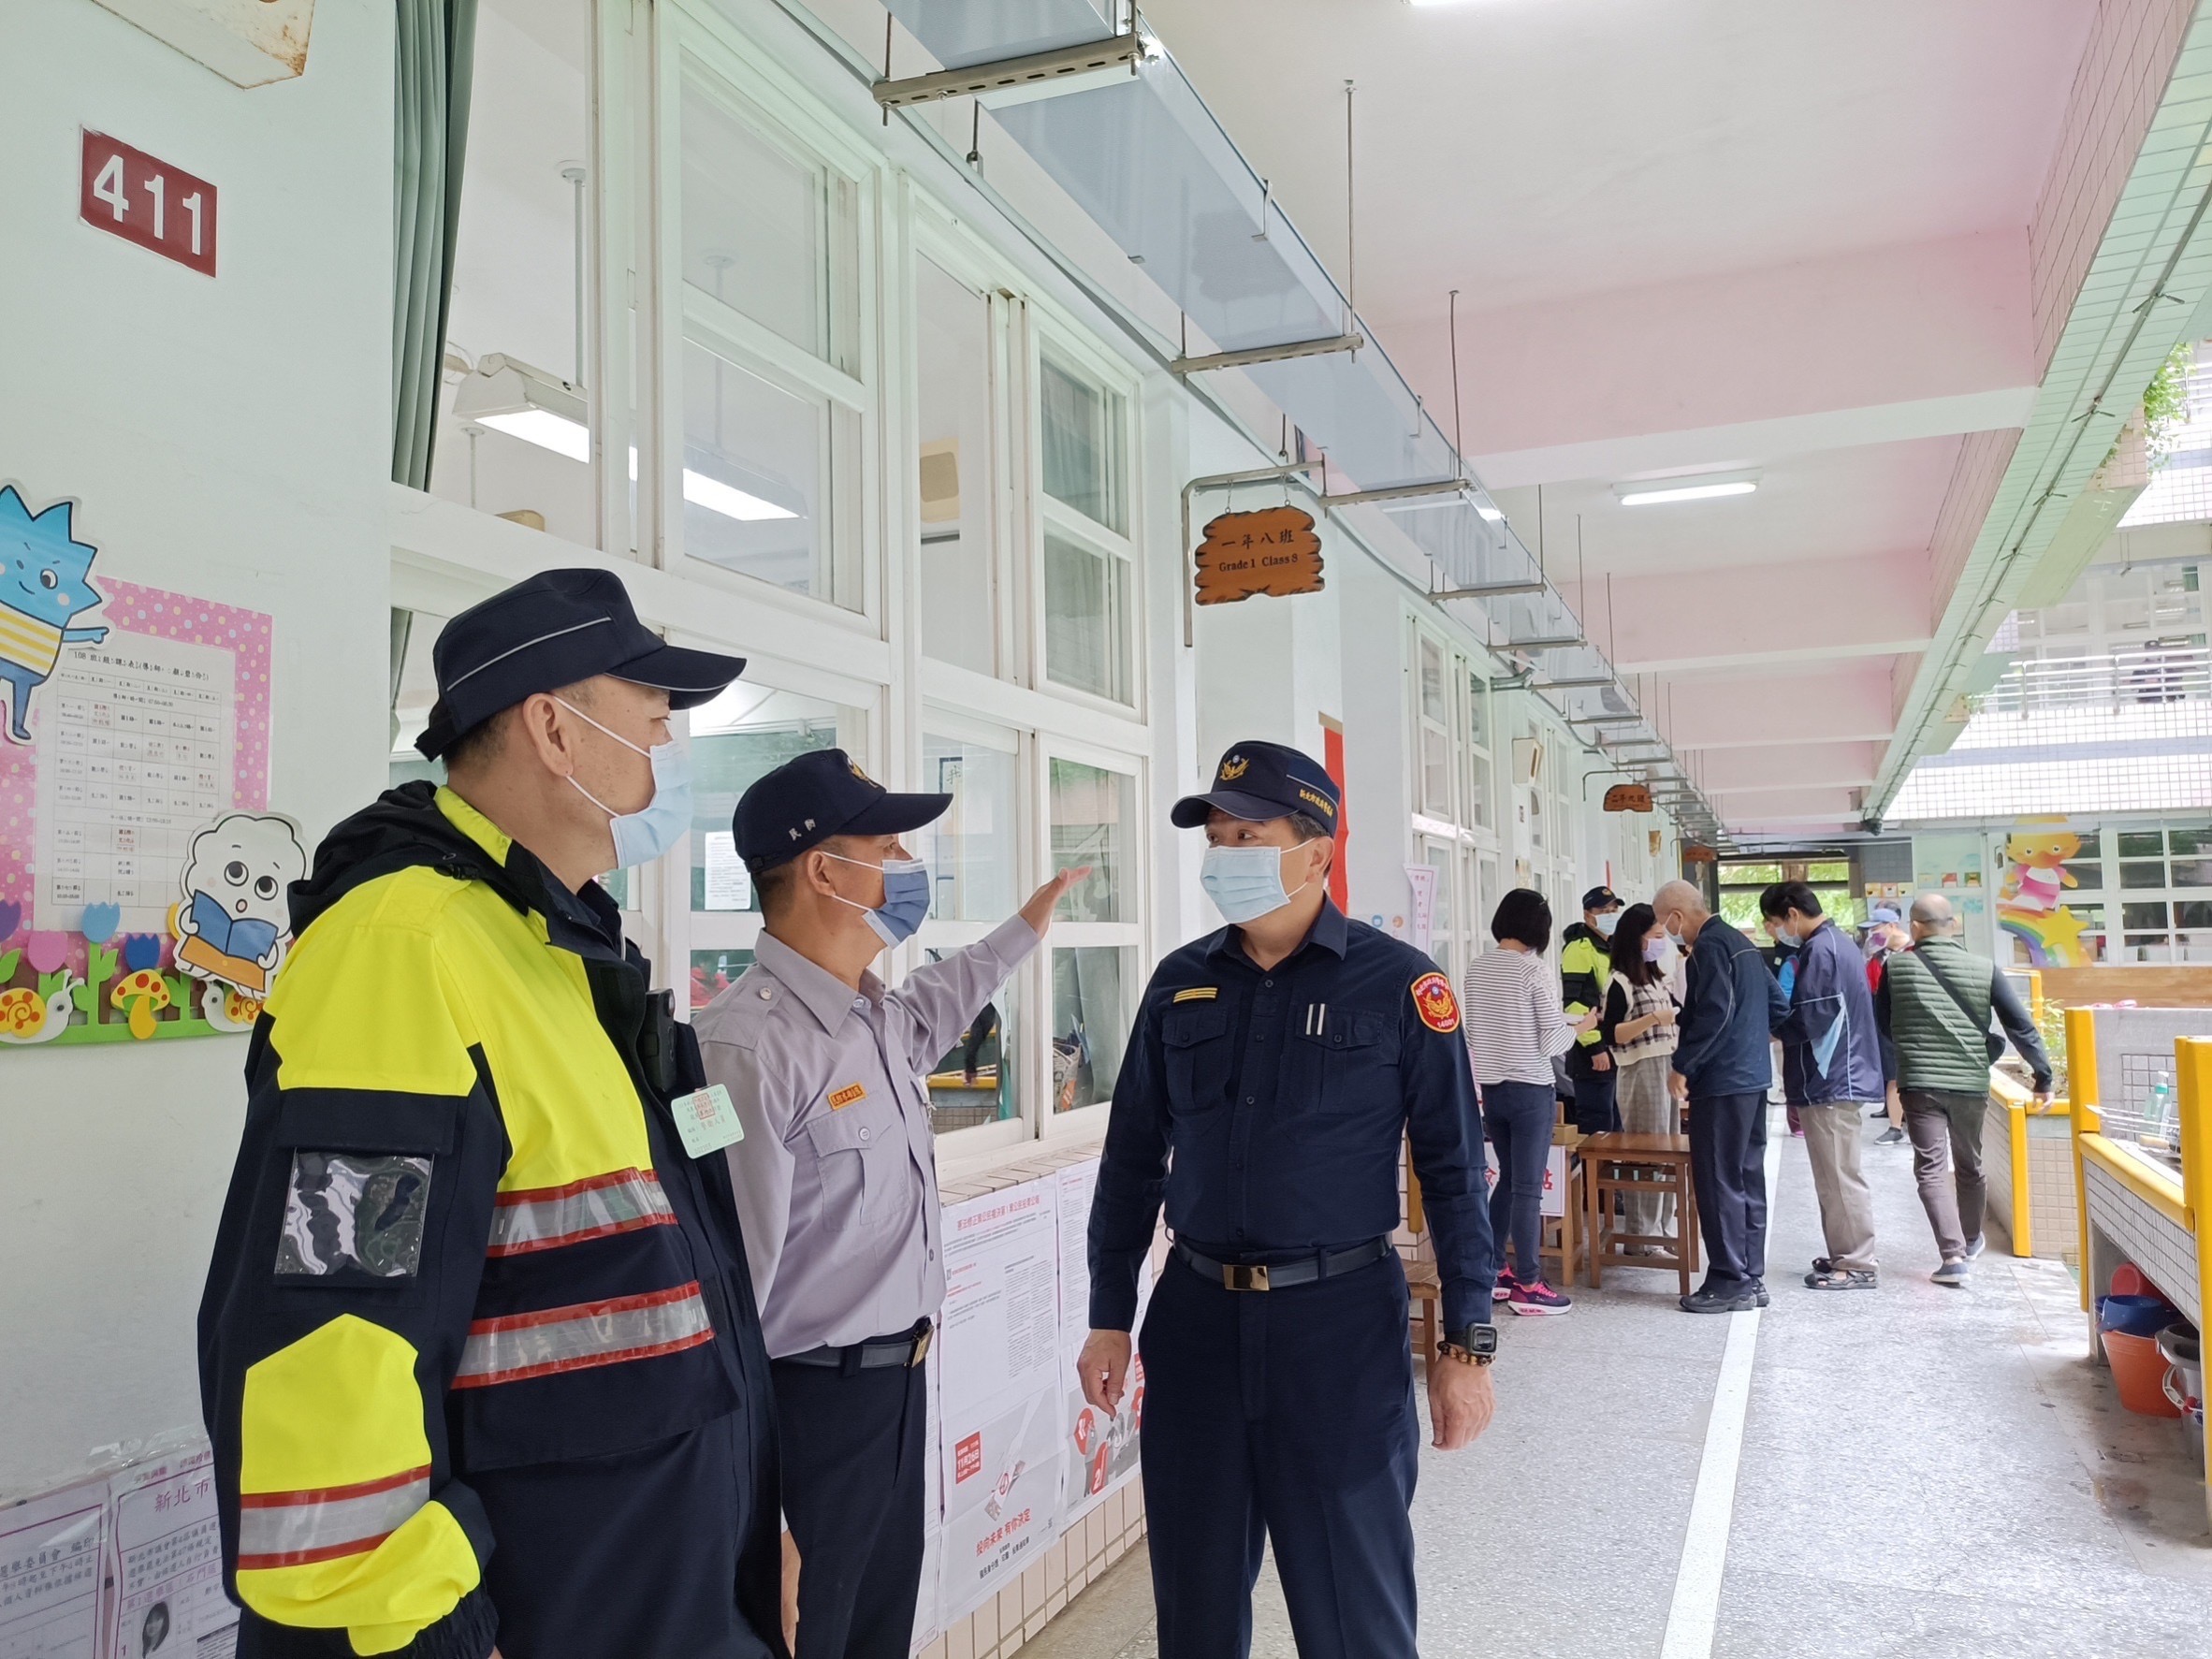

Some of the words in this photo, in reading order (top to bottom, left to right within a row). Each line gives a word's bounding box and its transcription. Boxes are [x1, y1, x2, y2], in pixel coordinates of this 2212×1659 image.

[93, 154, 201, 256] 411
[1221, 529, 1295, 550] 一年八班
[1219, 560, 1248, 572] Grade
[1251, 559, 1256, 569] 1
[1261, 556, 1289, 566] Class
[1291, 553, 1299, 563] 8
[154, 1477, 211, 1513] 新北市
